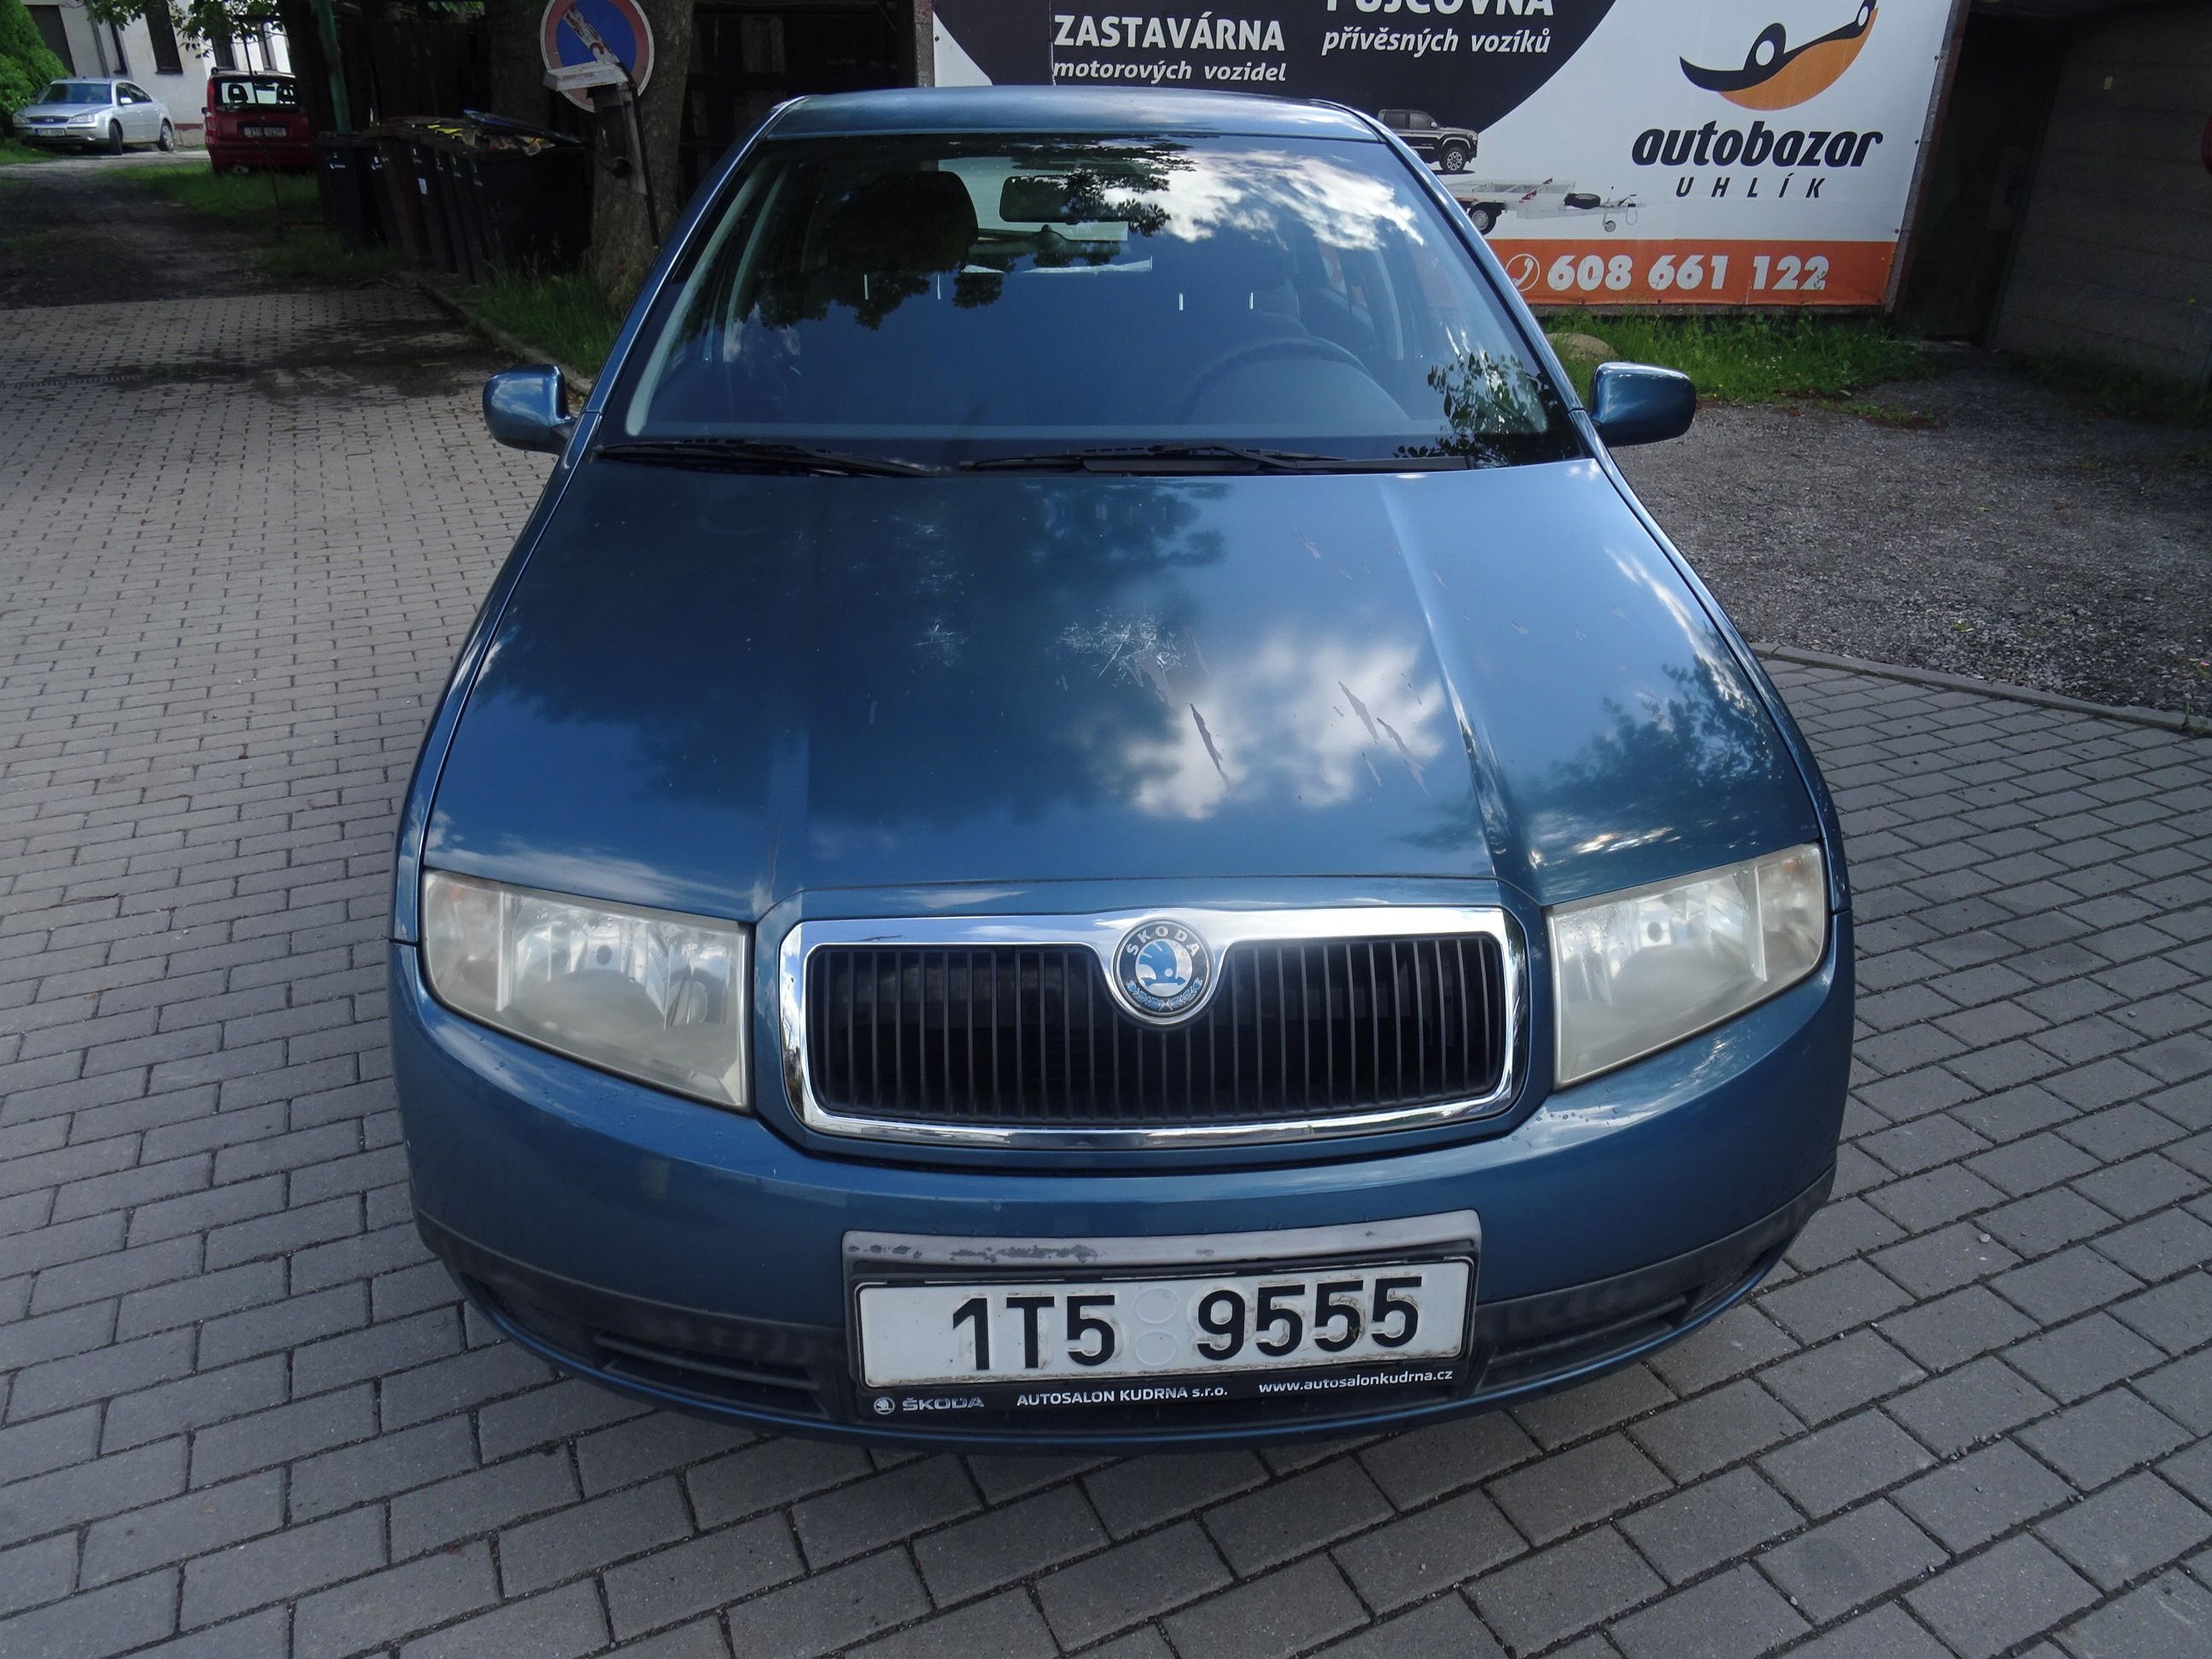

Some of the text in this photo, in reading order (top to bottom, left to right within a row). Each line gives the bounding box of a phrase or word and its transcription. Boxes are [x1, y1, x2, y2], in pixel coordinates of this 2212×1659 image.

[1054, 11, 1285, 51] ZASTAVÁRNA
[1321, 26, 1551, 58] přívěsných vozíků
[1053, 61, 1286, 84] motorových vozidel
[1632, 120, 1883, 167] autobazar
[1675, 172, 1826, 198] UHLÍK
[1547, 254, 1830, 291] 608 661 122
[952, 1276, 1423, 1371] 1T5 9555
[1259, 1370, 1453, 1393] www.autosalonkudrna.cz
[902, 1397, 985, 1412] ŠKODA
[1016, 1387, 1228, 1406] AUTOSALON KUDRNA s.r.o.
